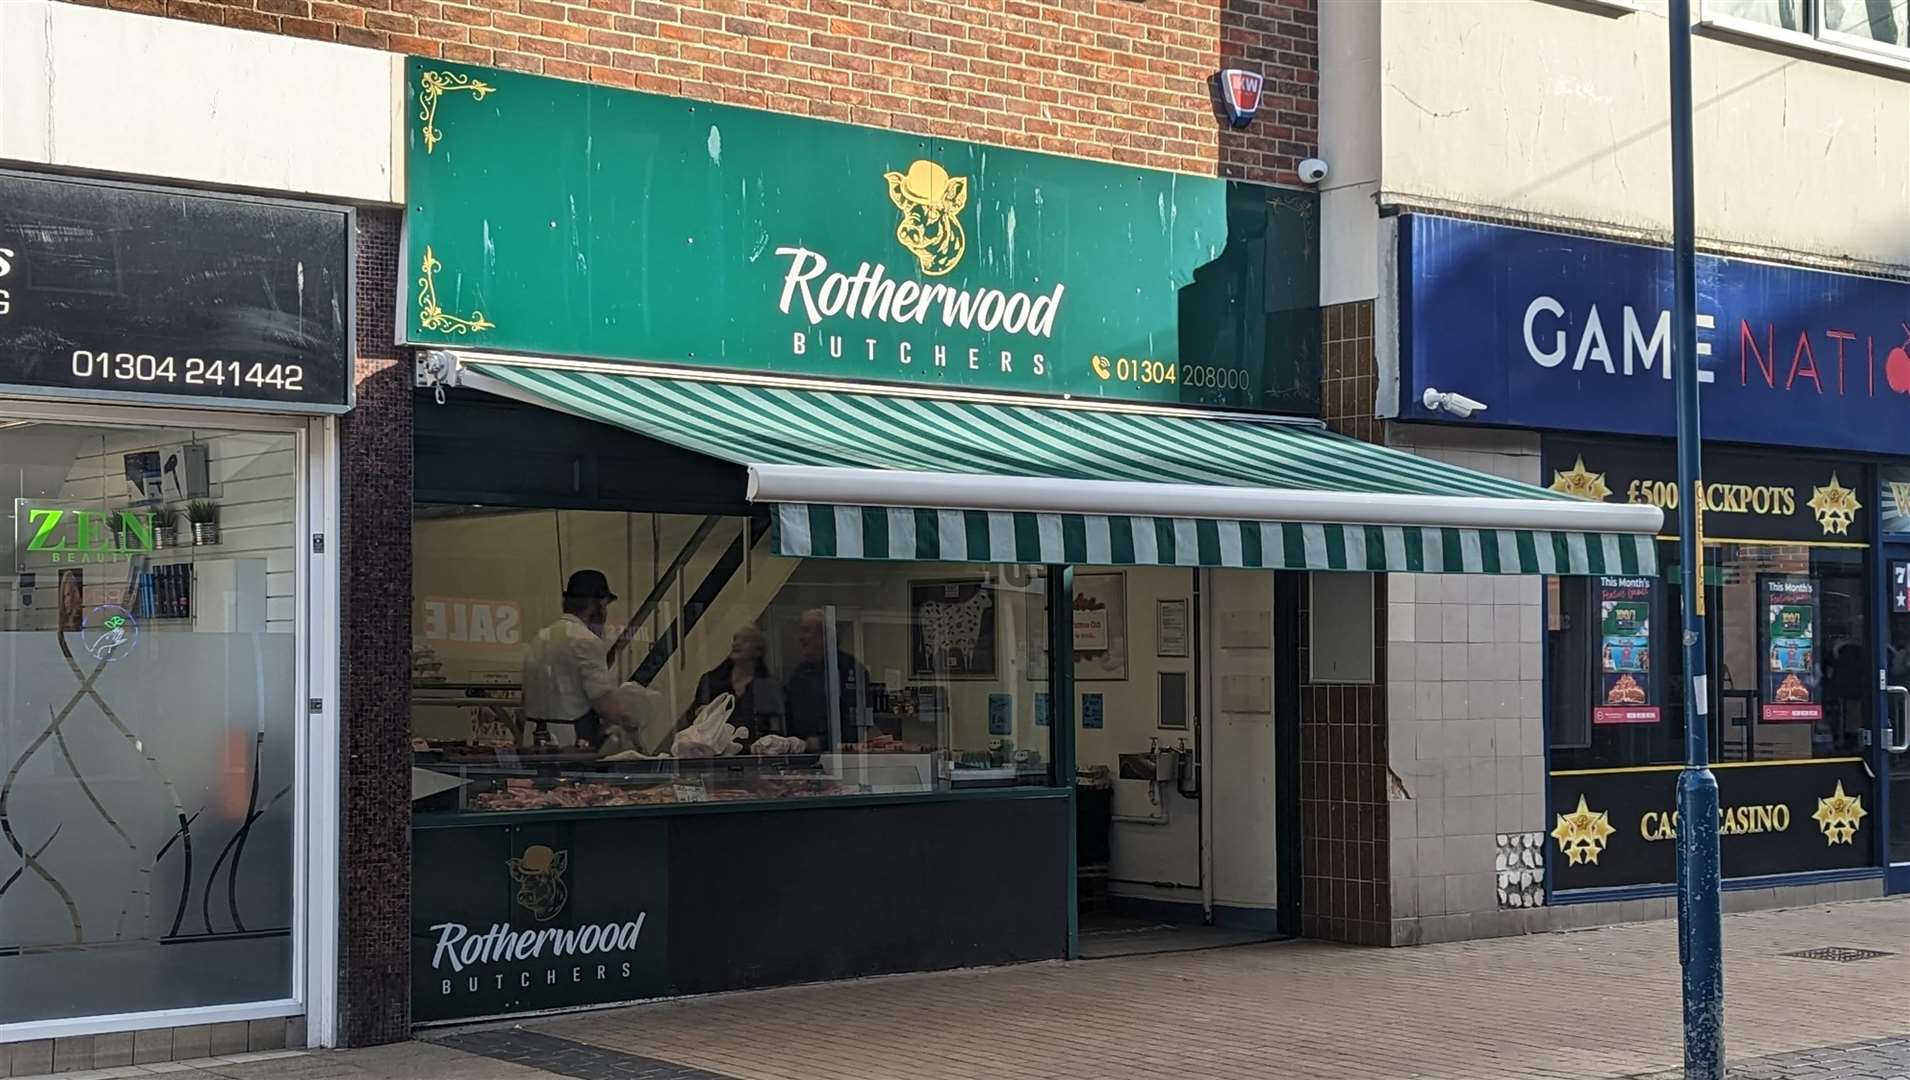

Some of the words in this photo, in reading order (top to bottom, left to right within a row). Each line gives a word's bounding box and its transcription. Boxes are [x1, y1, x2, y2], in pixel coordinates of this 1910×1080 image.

[775, 246, 1065, 337] Rotherwood
[793, 332, 1045, 376] BUTCHERS
[1523, 296, 1715, 383] GAME
[72, 350, 177, 383] 01304
[185, 357, 304, 391] 241442
[1116, 357, 1176, 385] 01304
[1182, 364, 1249, 391] 208000
[1627, 479, 1679, 510] £500
[26, 508, 158, 552] ZEN
[52, 552, 133, 562] BEAUTY
[1600, 576, 1617, 587] This
[1619, 577, 1650, 588] Month's
[1768, 581, 1784, 592] This
[1785, 583, 1813, 593] Month's
[429, 911, 646, 973] Rotherwood
[442, 962, 631, 995] BUTCHERS
